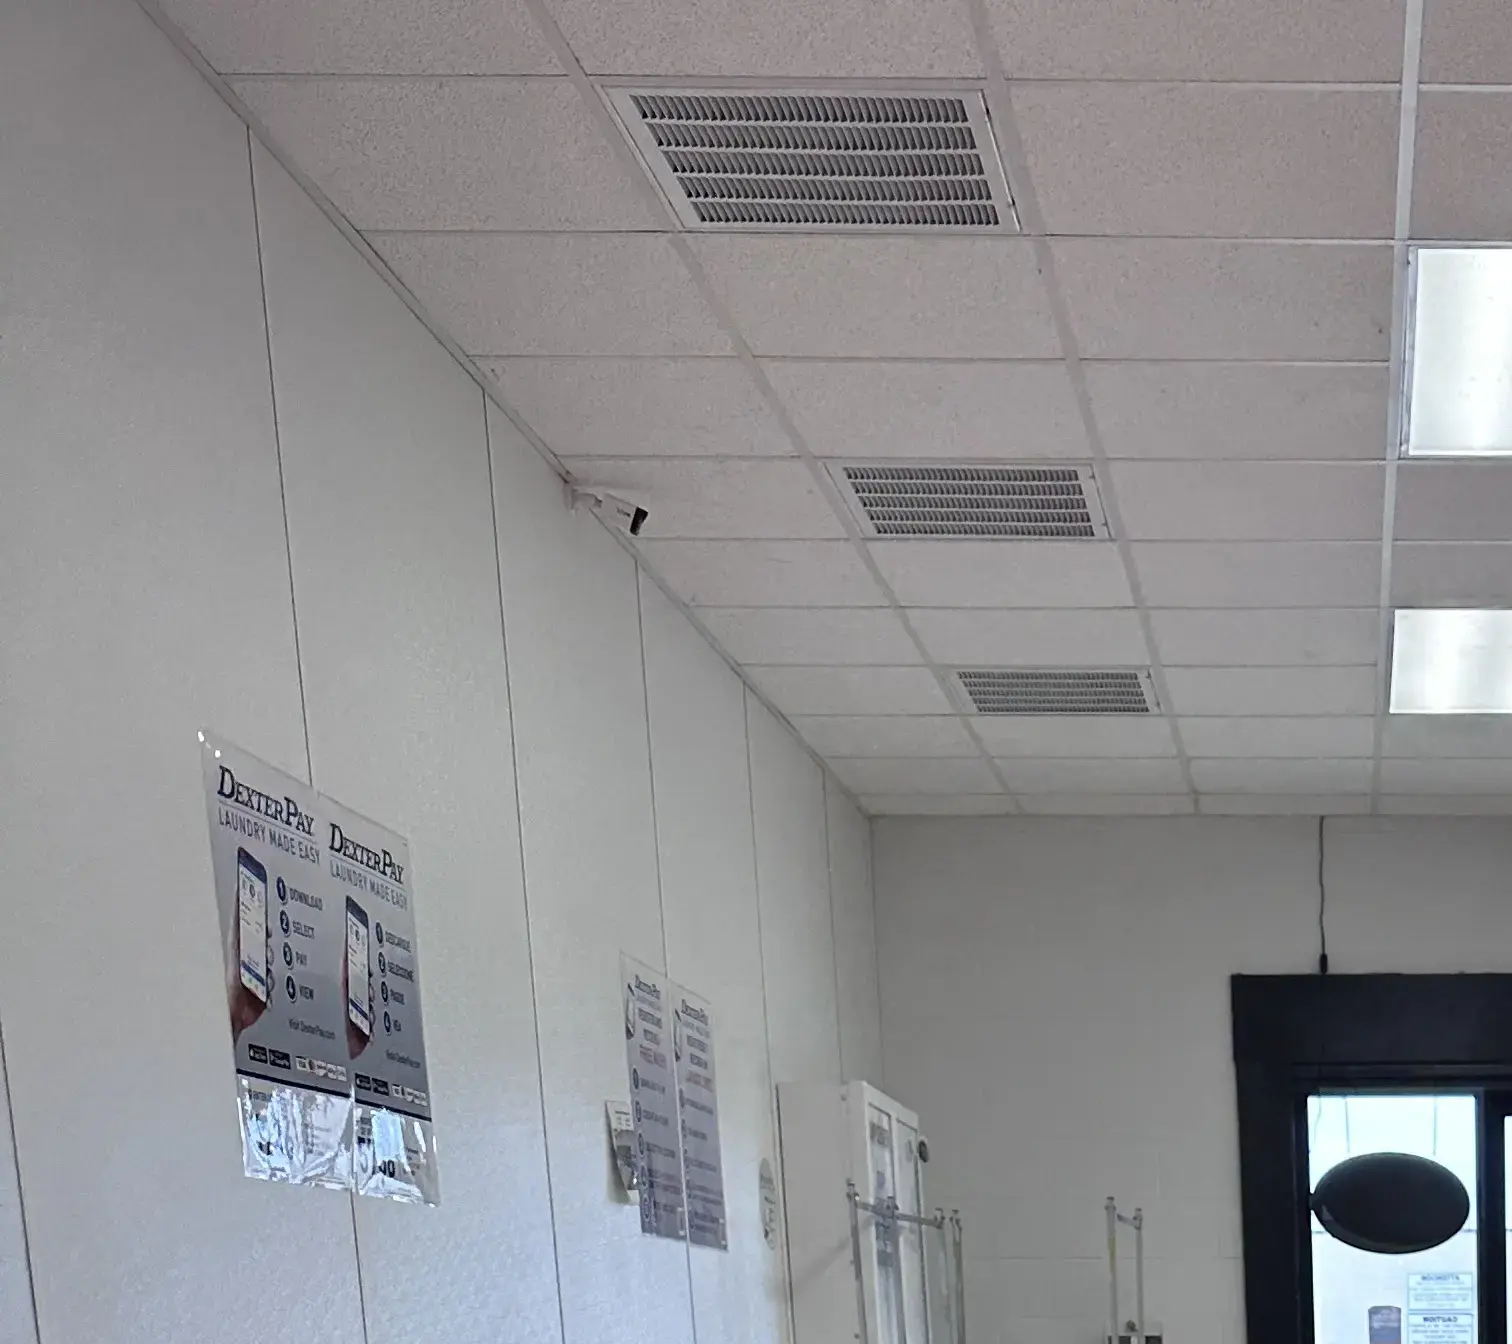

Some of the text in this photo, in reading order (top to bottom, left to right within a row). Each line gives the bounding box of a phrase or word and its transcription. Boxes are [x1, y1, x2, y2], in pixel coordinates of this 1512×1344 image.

[219, 807, 320, 866] LAUNDRY MADE EASY
[330, 860, 408, 911] LAUNDRY MADE EASY
[290, 887, 323, 911] DOWNLOAD
[292, 920, 315, 939] SELECT
[295, 951, 308, 966] PAY
[299, 985, 314, 1000] VIEW
